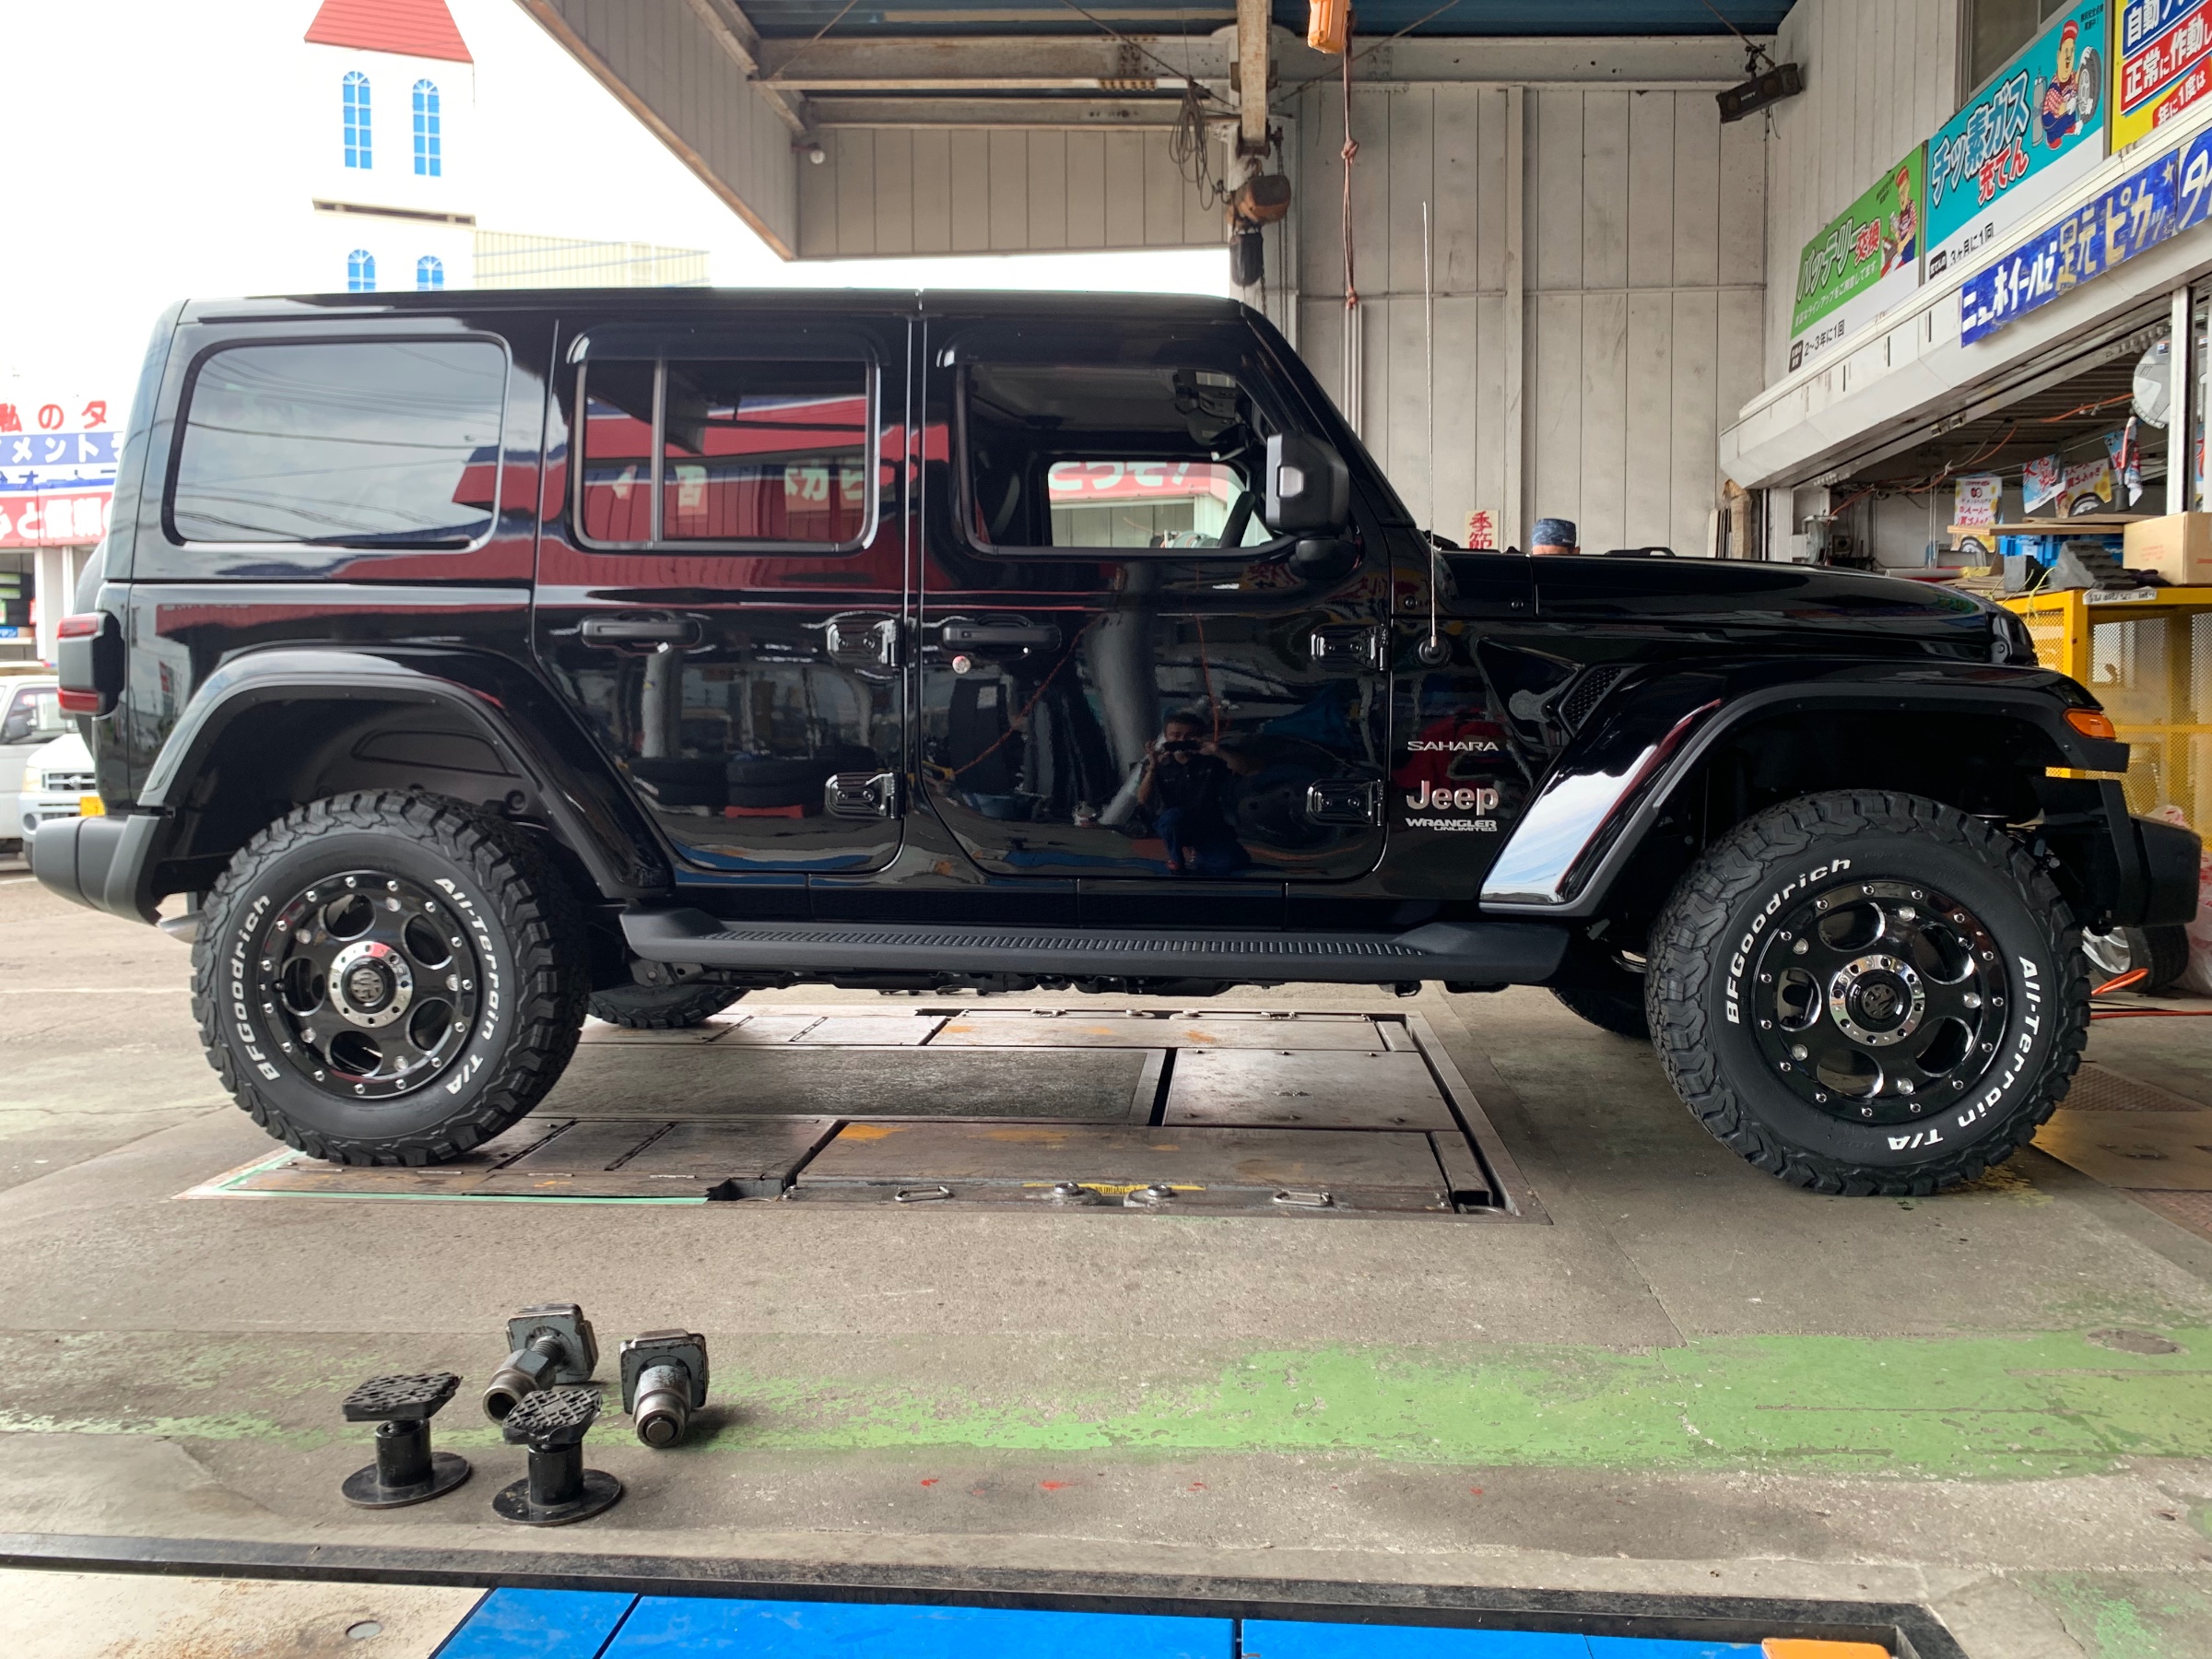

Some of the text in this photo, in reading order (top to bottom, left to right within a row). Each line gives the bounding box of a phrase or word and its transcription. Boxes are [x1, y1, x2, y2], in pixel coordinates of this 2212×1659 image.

[2127, 0, 2184, 47] 自動
[1931, 69, 2030, 209] チッ素ガス
[1977, 136, 2030, 206] 充てん
[0, 433, 124, 463] メント
[1407, 740, 1499, 751] SAHARA
[1405, 818, 1497, 828] WRANGLER
[1406, 780, 1499, 816] Jeep
[1726, 858, 1852, 1025] BFGoodrich
[229, 894, 280, 1081] BFGoodrich
[434, 877, 501, 1095] All-Terrain T/A
[1888, 956, 2041, 1151] All-Terrain T/A
